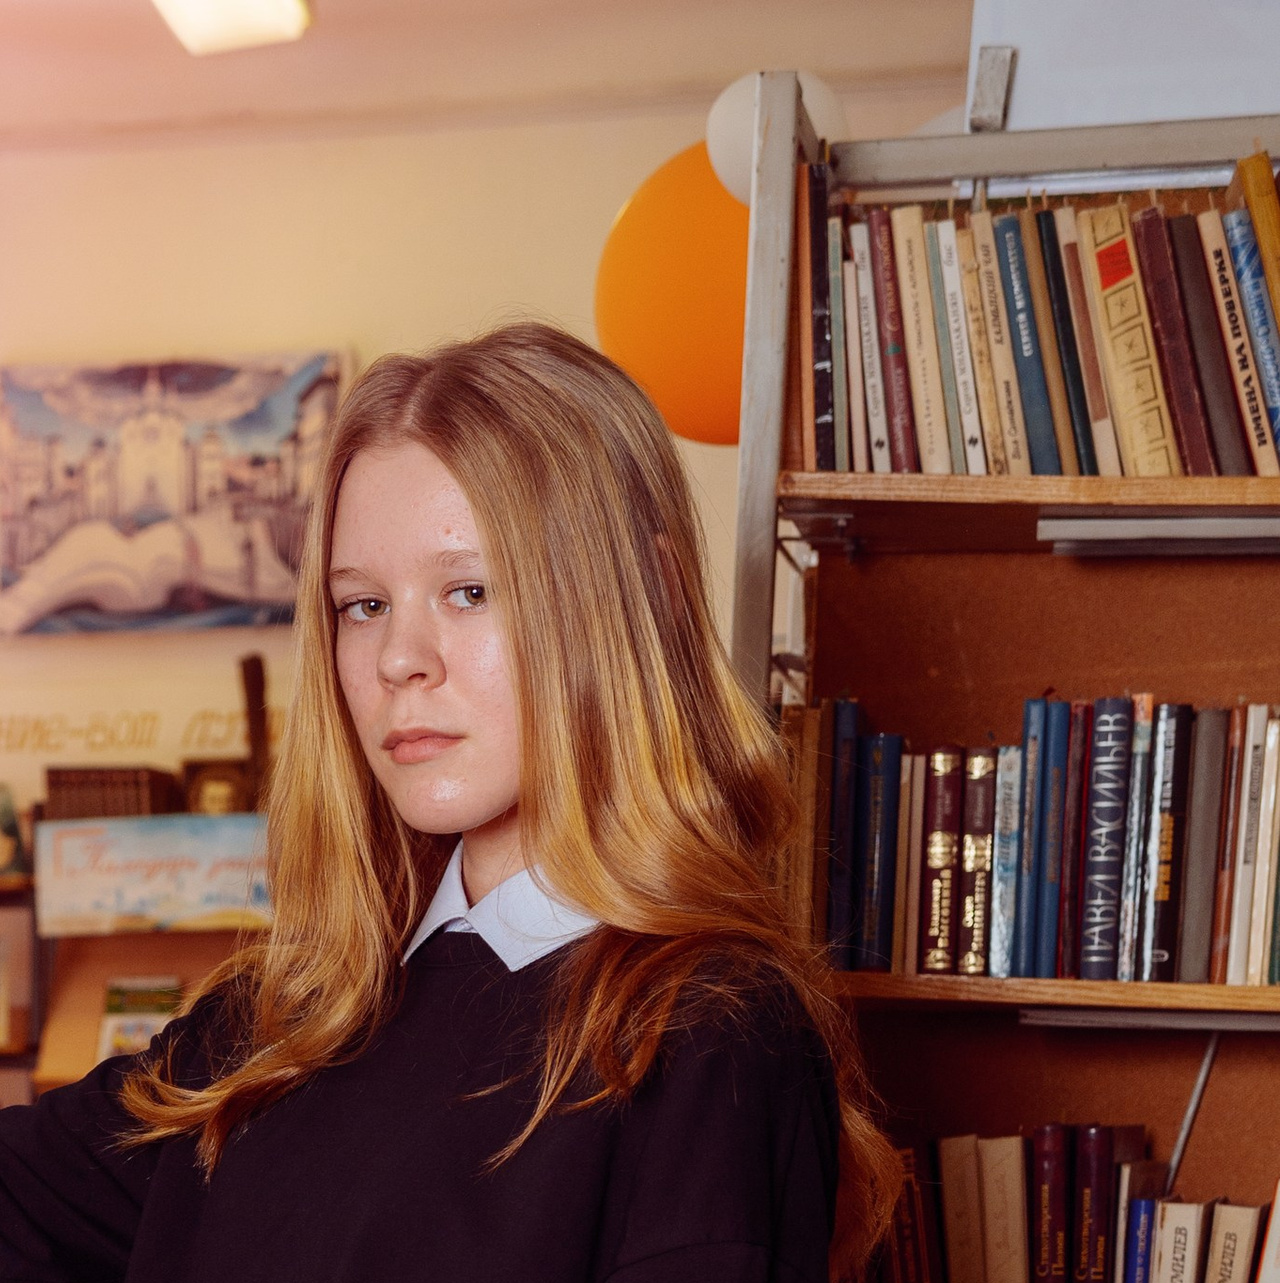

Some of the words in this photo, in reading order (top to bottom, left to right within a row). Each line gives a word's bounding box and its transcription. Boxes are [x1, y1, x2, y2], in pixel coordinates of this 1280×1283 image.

[1212, 248, 1241, 339] ПОВЕРКЕ
[1234, 343, 1250, 372] НА
[1242, 374, 1267, 447] ИМЕНА
[1088, 712, 1128, 862] ВАСИЛЬЕВ
[1082, 874, 1119, 961] ПАВЕЛ
